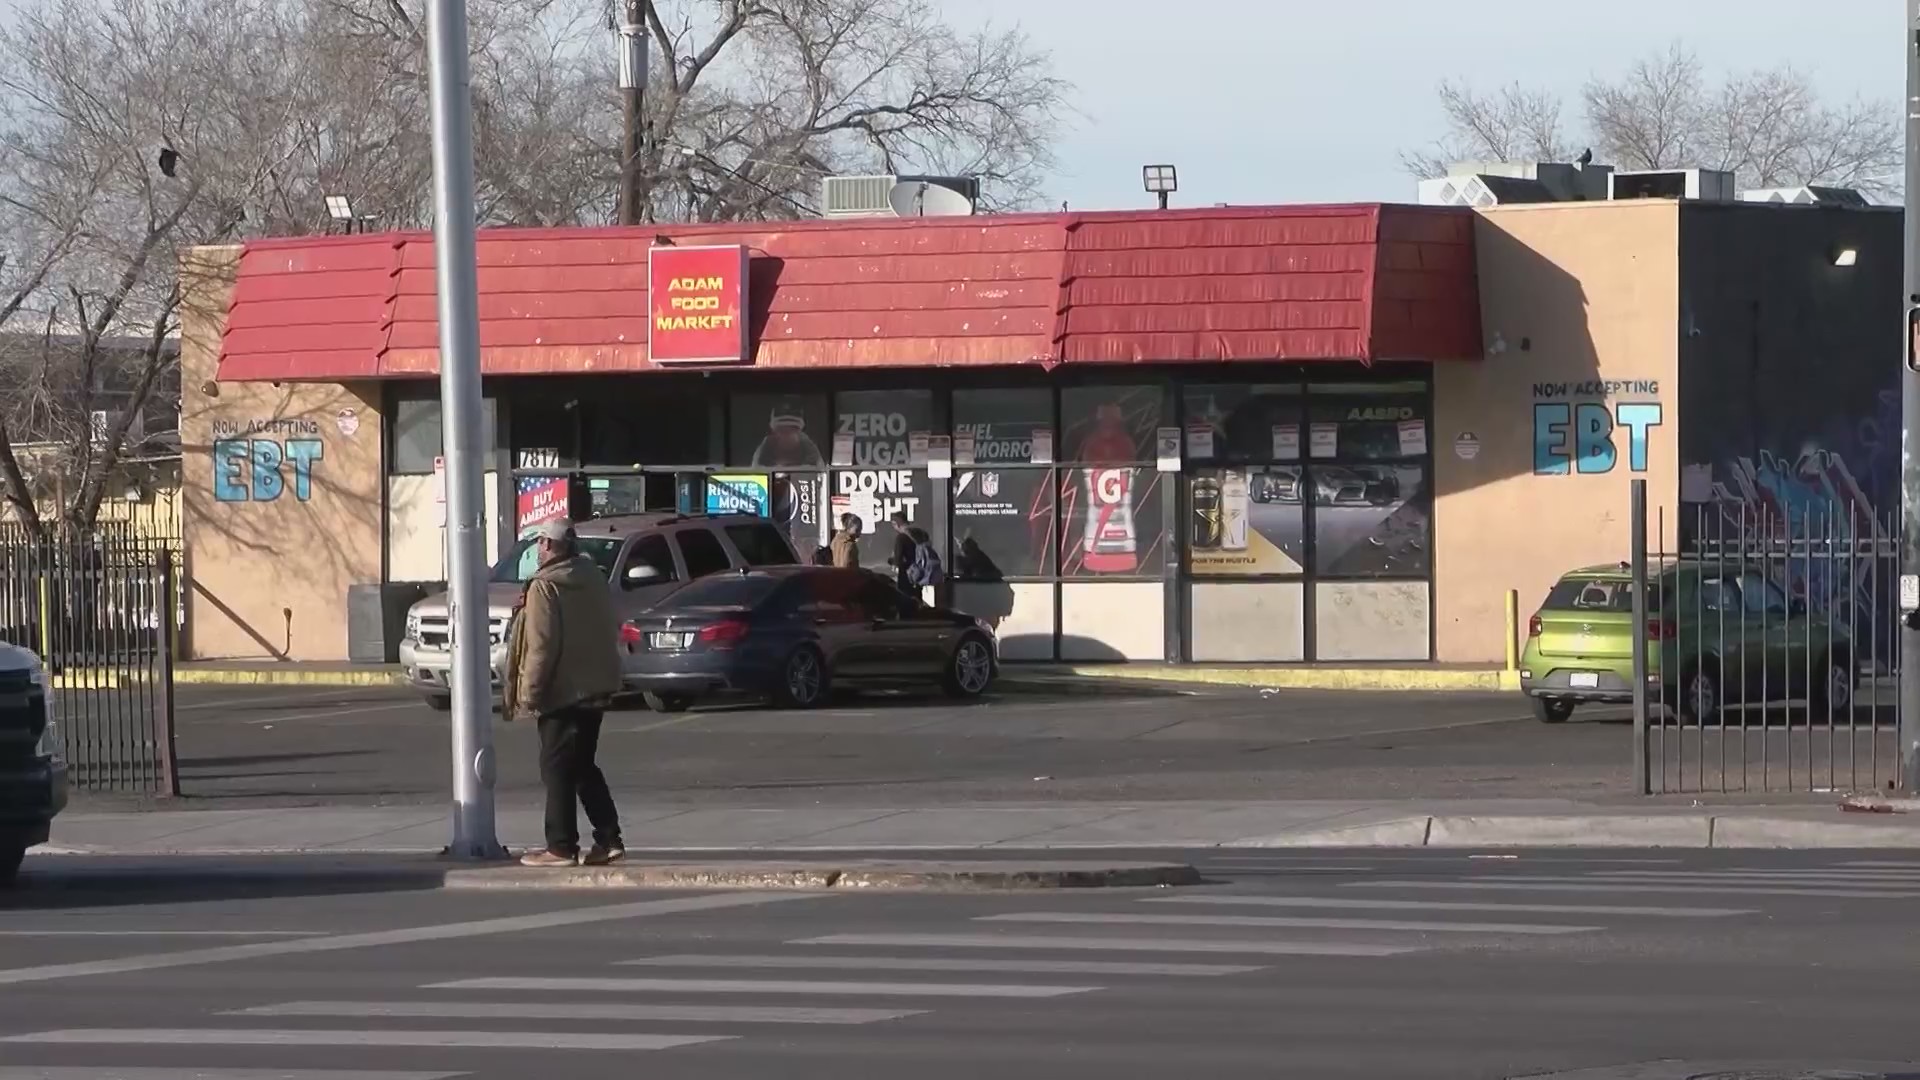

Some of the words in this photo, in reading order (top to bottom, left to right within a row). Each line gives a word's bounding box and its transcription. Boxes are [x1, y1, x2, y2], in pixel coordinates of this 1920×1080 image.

[667, 277, 723, 292] ADAM
[671, 296, 719, 310] FOOD
[656, 315, 733, 330] MARKET
[1533, 382, 1567, 398] NOW
[1574, 380, 1659, 396] ACCEPTING
[213, 420, 238, 434] NOW
[247, 419, 318, 435] ACCEPTING
[839, 412, 907, 437] ZERO
[1533, 402, 1663, 476] EBT
[520, 448, 558, 469] 7817
[855, 441, 911, 465] UGA
[213, 438, 324, 502] EBT
[707, 482, 747, 496] RIGHT
[839, 470, 913, 494] DONE
[1097, 469, 1121, 504] G
[533, 487, 555, 508] BUY
[718, 495, 766, 509] MONEY
[799, 480, 811, 524] pepsi
[520, 497, 568, 528] AMERICAN
[872, 497, 919, 522] GHT
